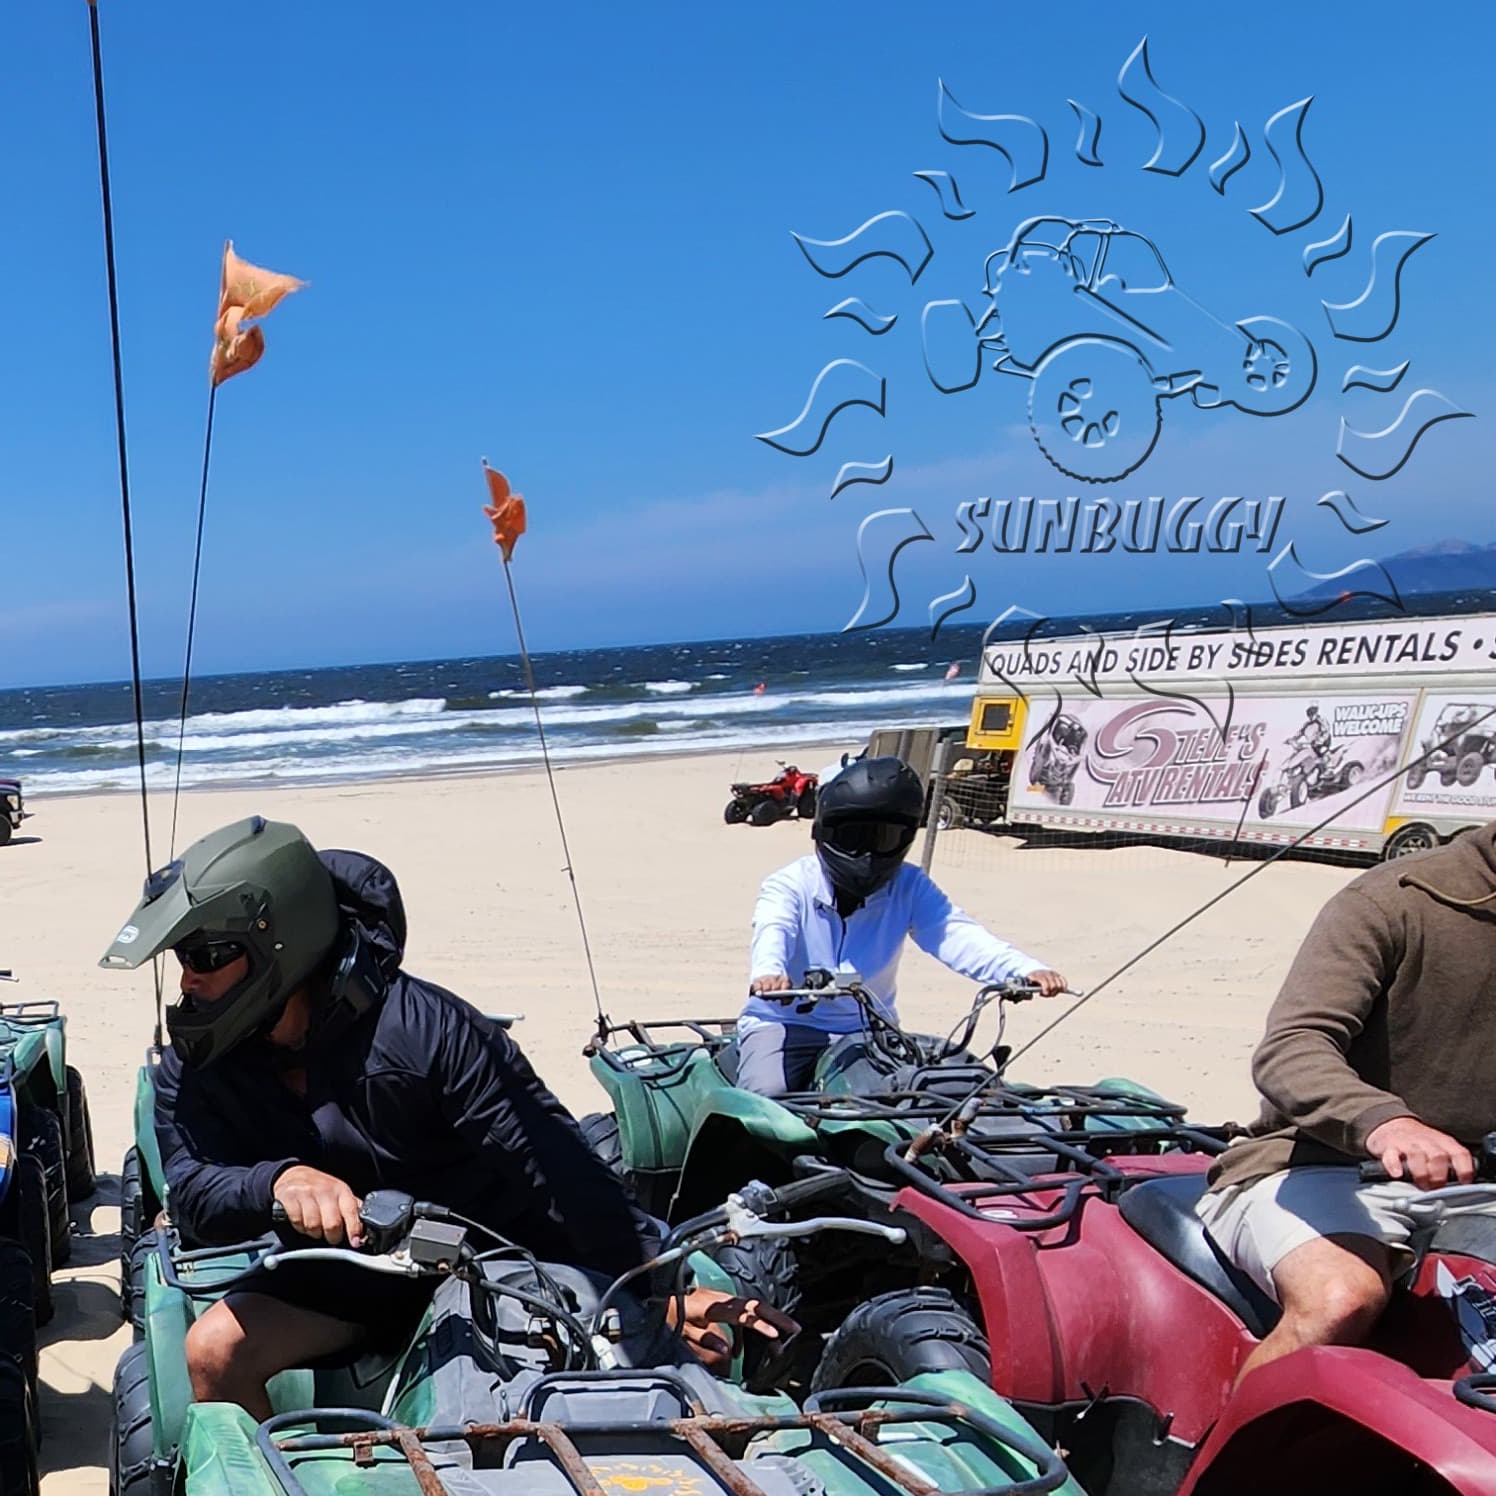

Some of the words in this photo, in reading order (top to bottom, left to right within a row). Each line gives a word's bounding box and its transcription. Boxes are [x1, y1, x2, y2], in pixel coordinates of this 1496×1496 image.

[991, 650, 1062, 676] QUADS
[1067, 649, 1119, 674] AND
[1125, 646, 1180, 673] SIDE
[1187, 643, 1224, 670] BY
[1228, 639, 1309, 669] SIDES
[1317, 630, 1462, 666] RENTALS
[1333, 718, 1405, 737] WELCOME
[1335, 703, 1408, 722] WALK-UPS
[1103, 767, 1155, 808] ATV
[1150, 761, 1269, 806] RENTALS
